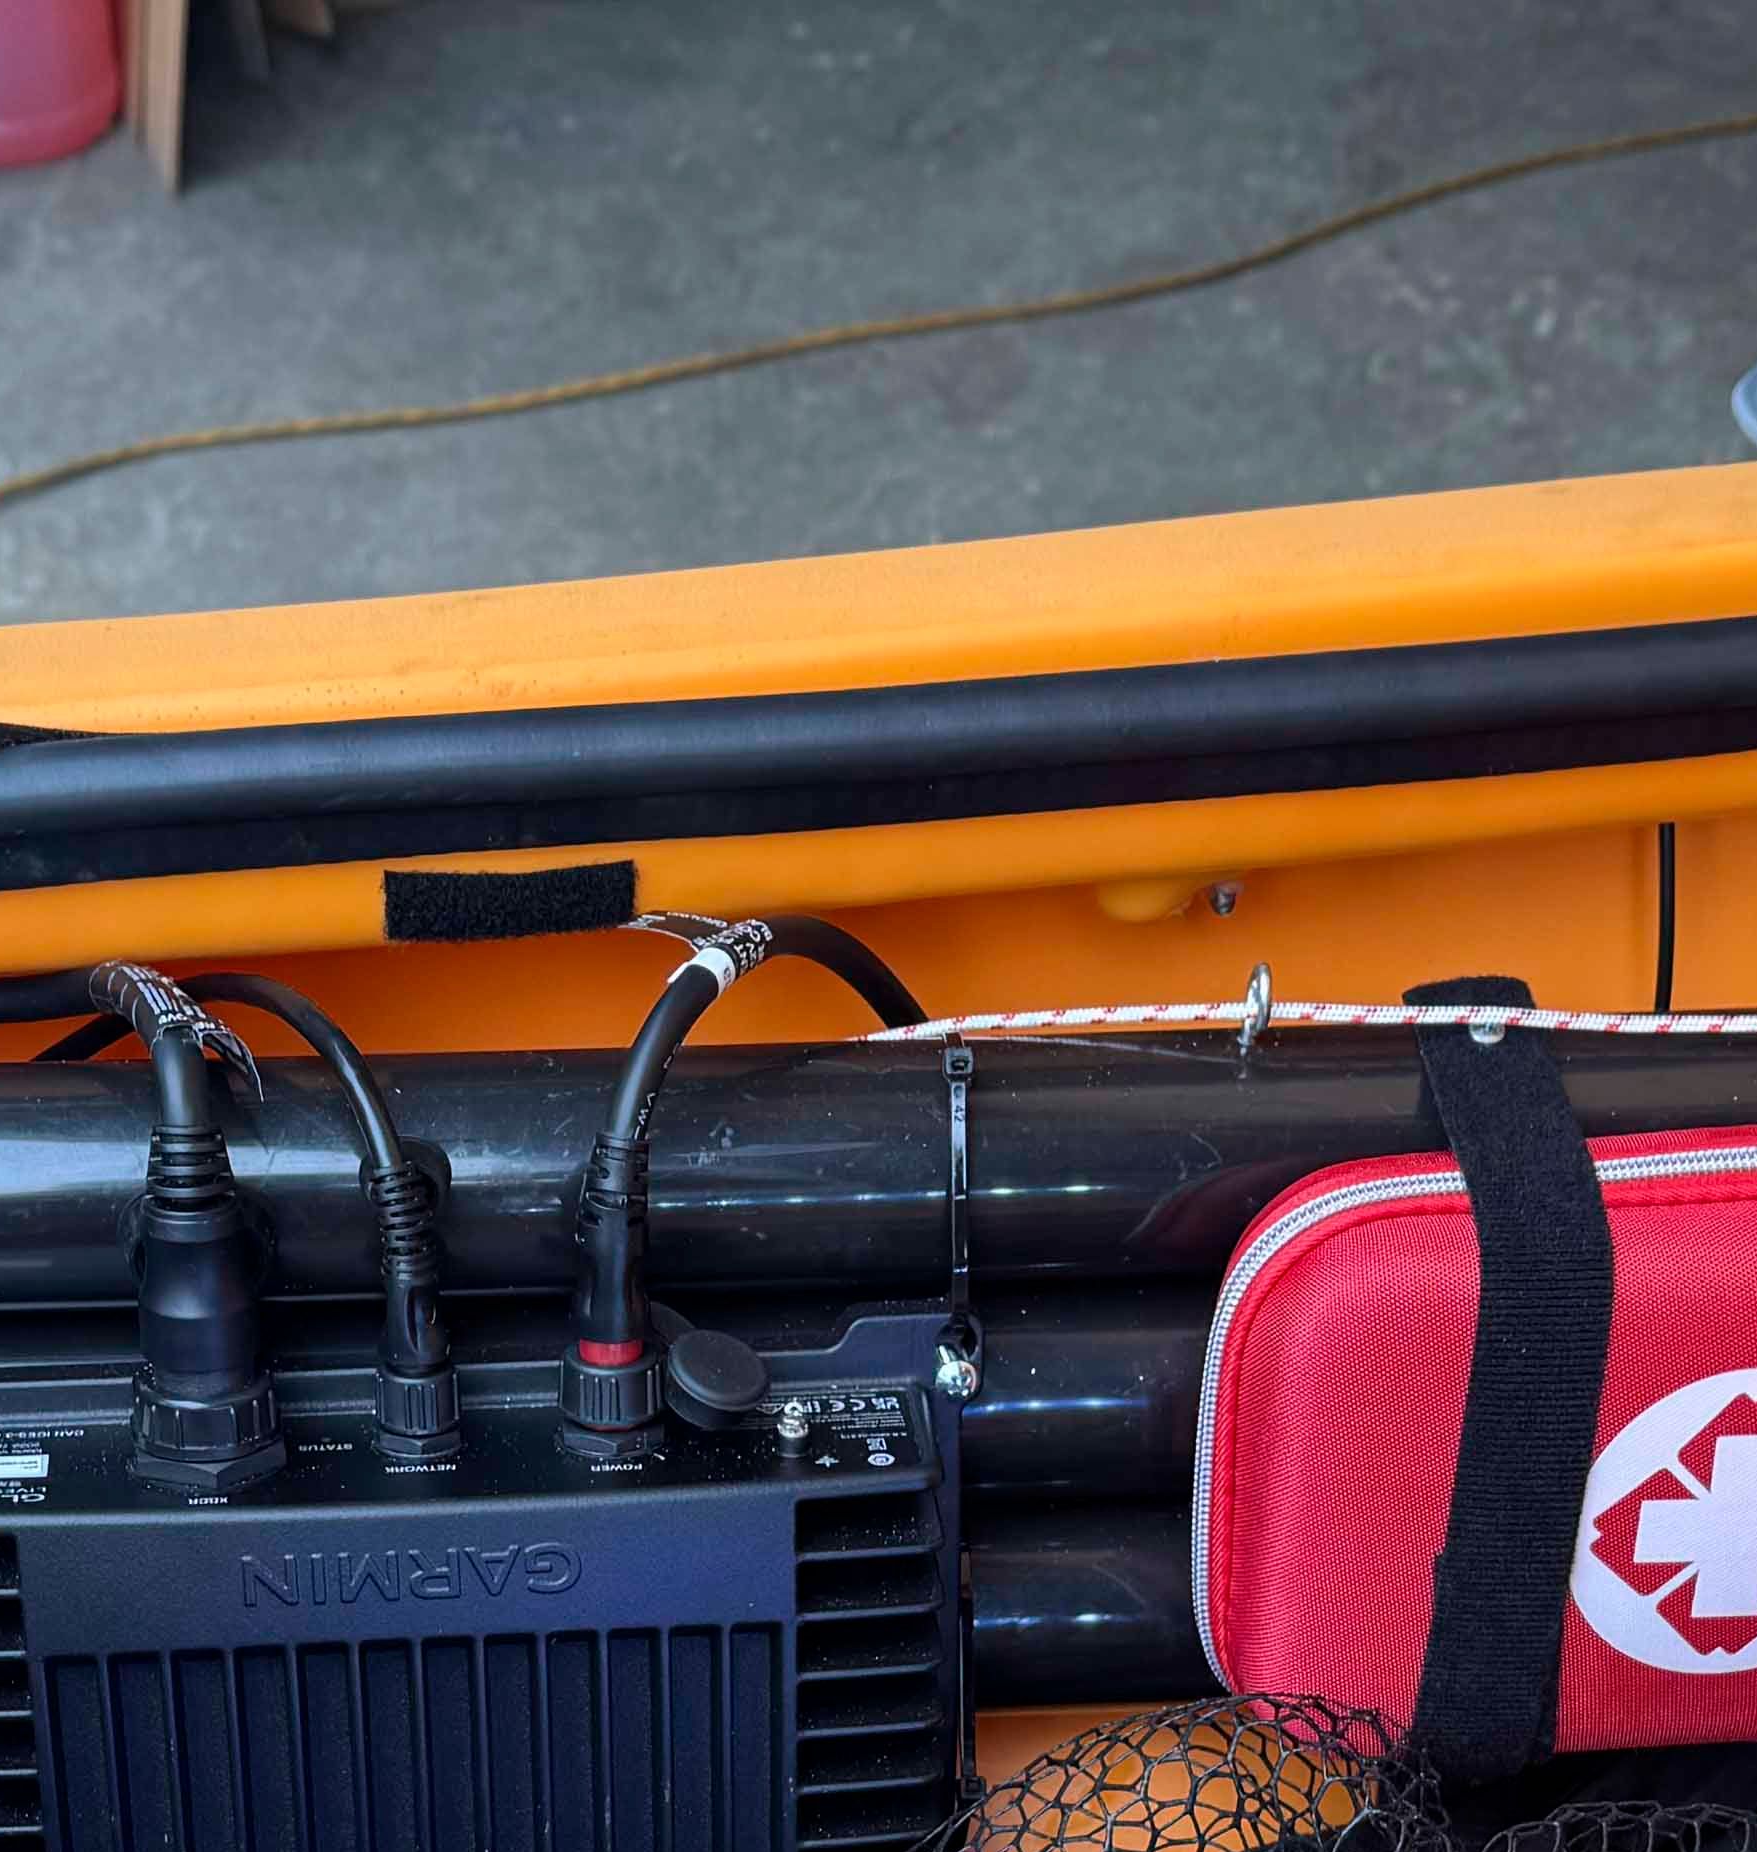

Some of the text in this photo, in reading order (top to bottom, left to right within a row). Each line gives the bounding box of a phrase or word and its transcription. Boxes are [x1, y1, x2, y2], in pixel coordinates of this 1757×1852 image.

[297, 1442, 353, 1453] STATUS
[384, 1464, 457, 1475] NETWORK
[590, 1463, 644, 1473] POWER
[238, 1541, 584, 1609] GARMIN
